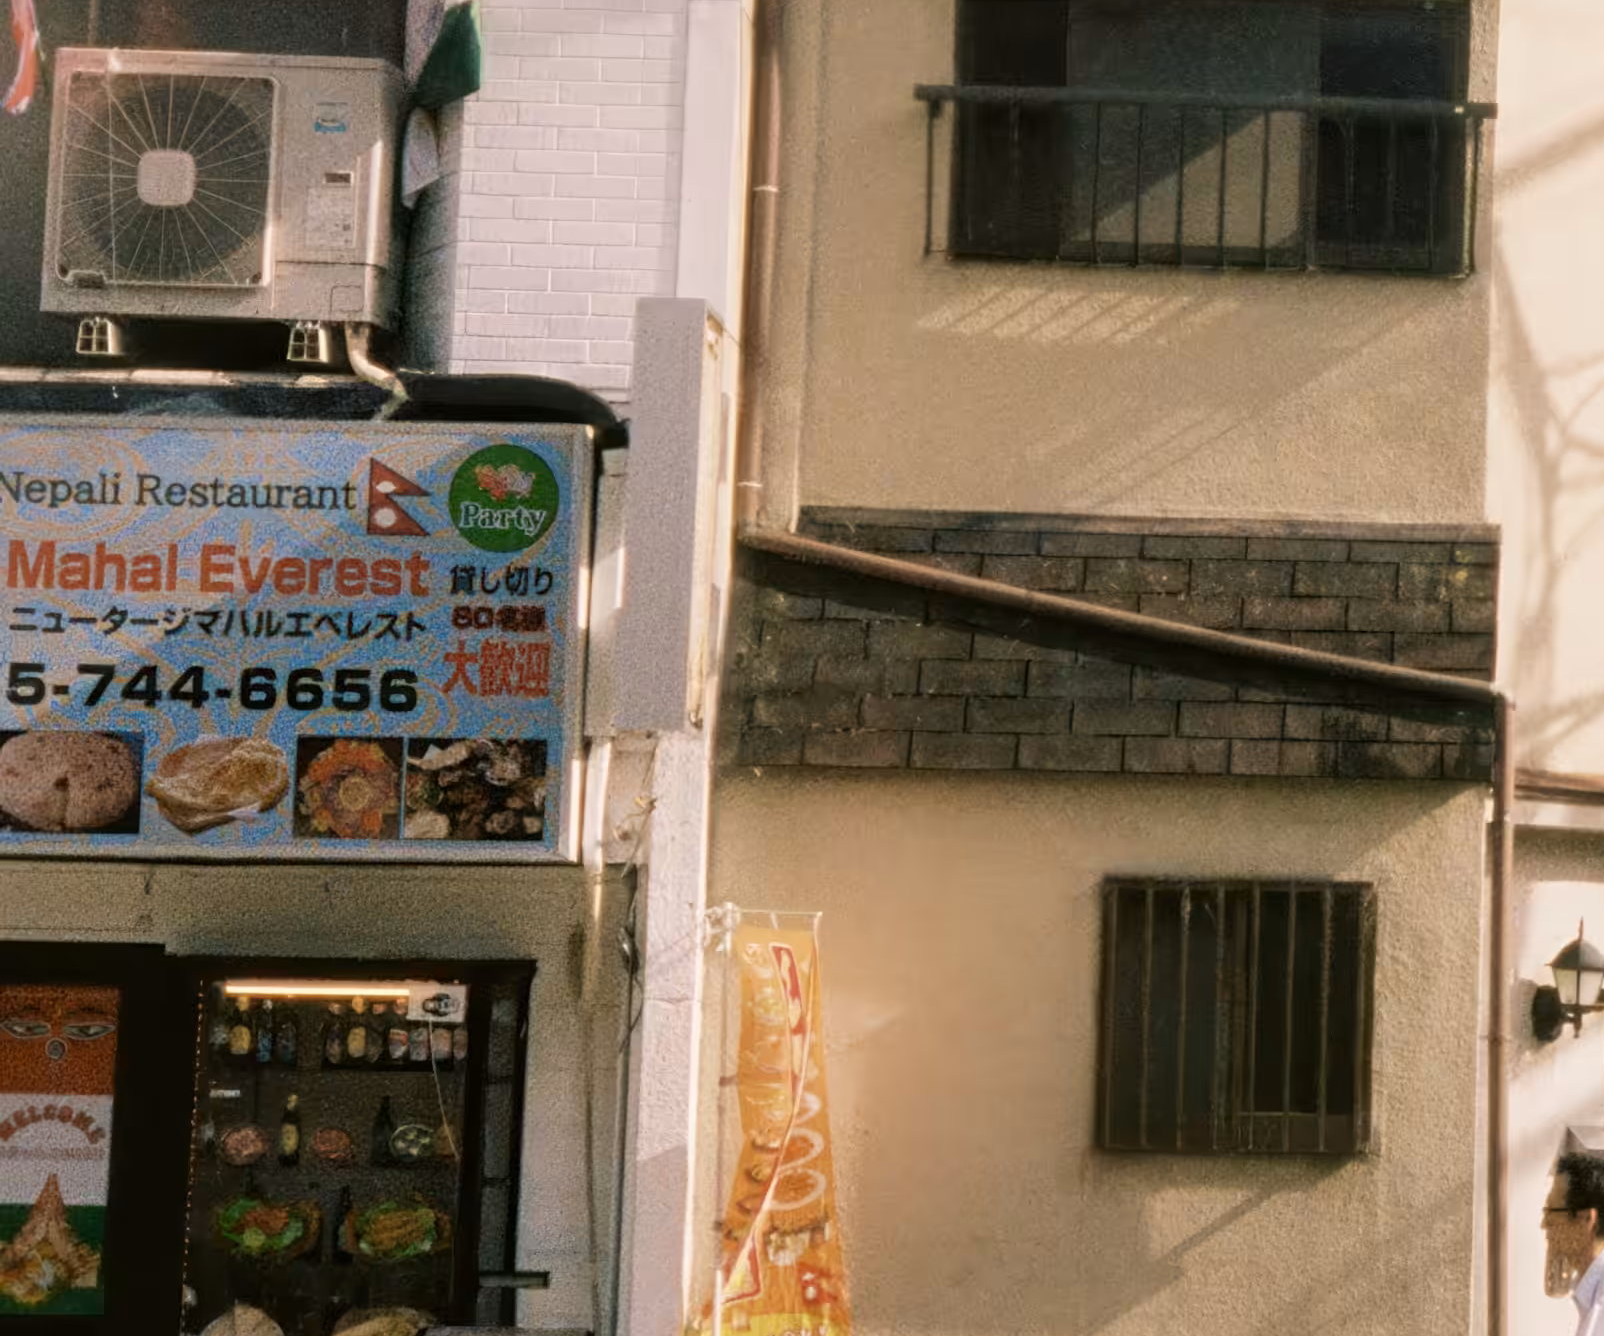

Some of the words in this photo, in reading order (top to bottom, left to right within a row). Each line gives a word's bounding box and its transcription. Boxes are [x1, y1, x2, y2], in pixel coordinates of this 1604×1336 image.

[0, 471, 121, 508] Nepali
[135, 474, 357, 510] Restaurant
[459, 501, 546, 537] Party
[7, 540, 178, 592] Mahal
[200, 544, 431, 597] Everest
[450, 565, 554, 595] 貸し切り
[9, 606, 426, 642] ニュータージマハルエベレスト
[6, 663, 418, 712] 5-744-6656
